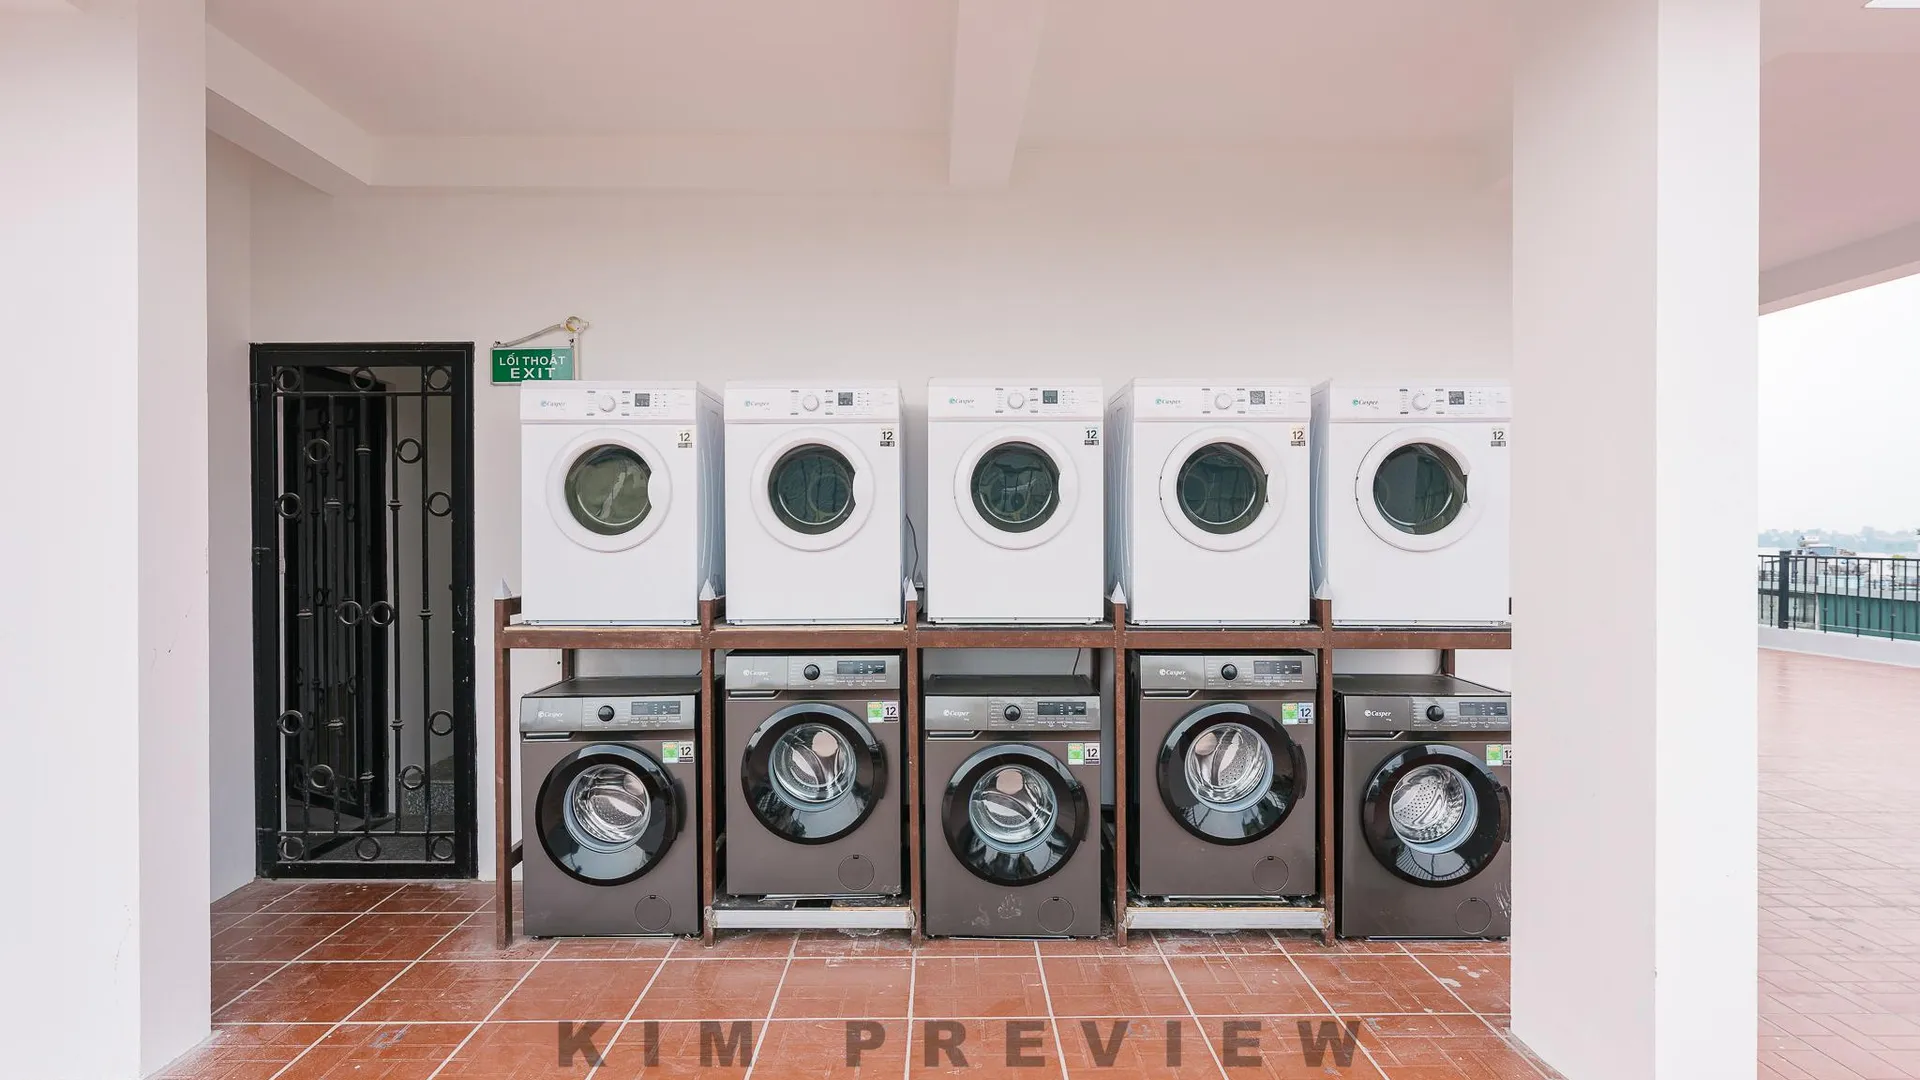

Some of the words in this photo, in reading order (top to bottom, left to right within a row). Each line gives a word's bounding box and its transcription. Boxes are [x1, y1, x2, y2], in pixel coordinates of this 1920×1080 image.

[499, 353, 519, 366] LỐI
[522, 353, 566, 366] THOÁT
[510, 367, 556, 379] EXIT
[679, 432, 691, 442] 12
[881, 431, 893, 441] 12
[1086, 429, 1097, 439] 12
[1292, 430, 1304, 440] 12
[1492, 430, 1504, 440] 12
[885, 706, 897, 716] 12
[1300, 707, 1312, 717] 12
[680, 746, 692, 756] 12
[1086, 748, 1098, 758] 12
